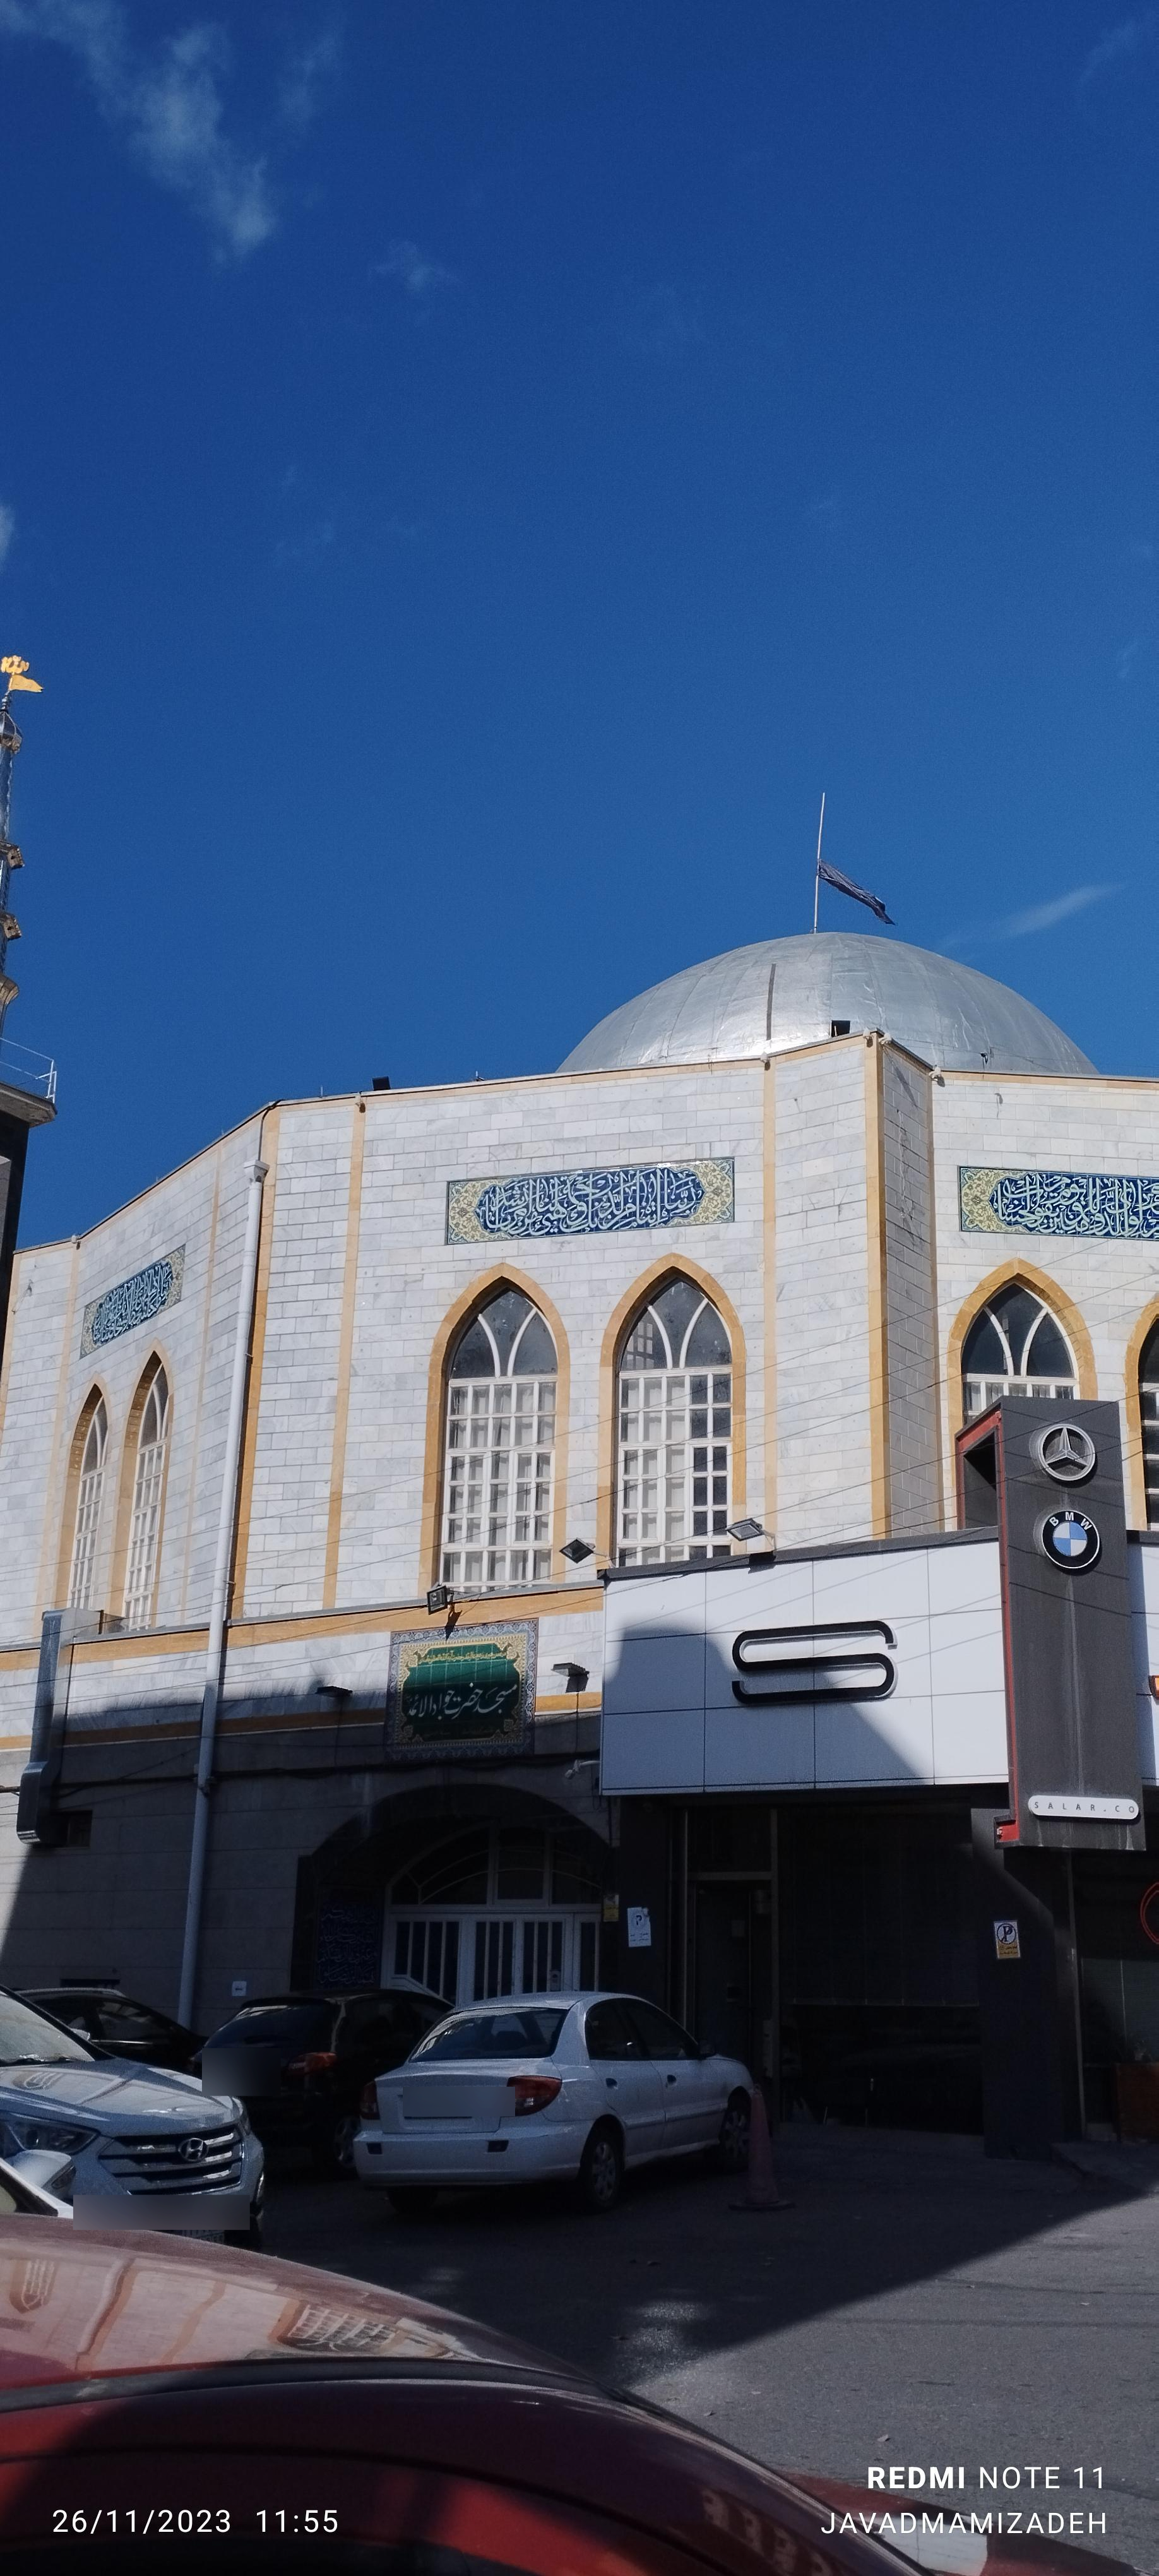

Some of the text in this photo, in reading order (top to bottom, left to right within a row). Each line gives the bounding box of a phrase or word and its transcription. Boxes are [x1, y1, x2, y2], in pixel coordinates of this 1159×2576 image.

[1049, 1512, 1092, 1530] BMW
[444, 1682, 484, 1720] حضرت
[475, 1684, 518, 1714] مسجد
